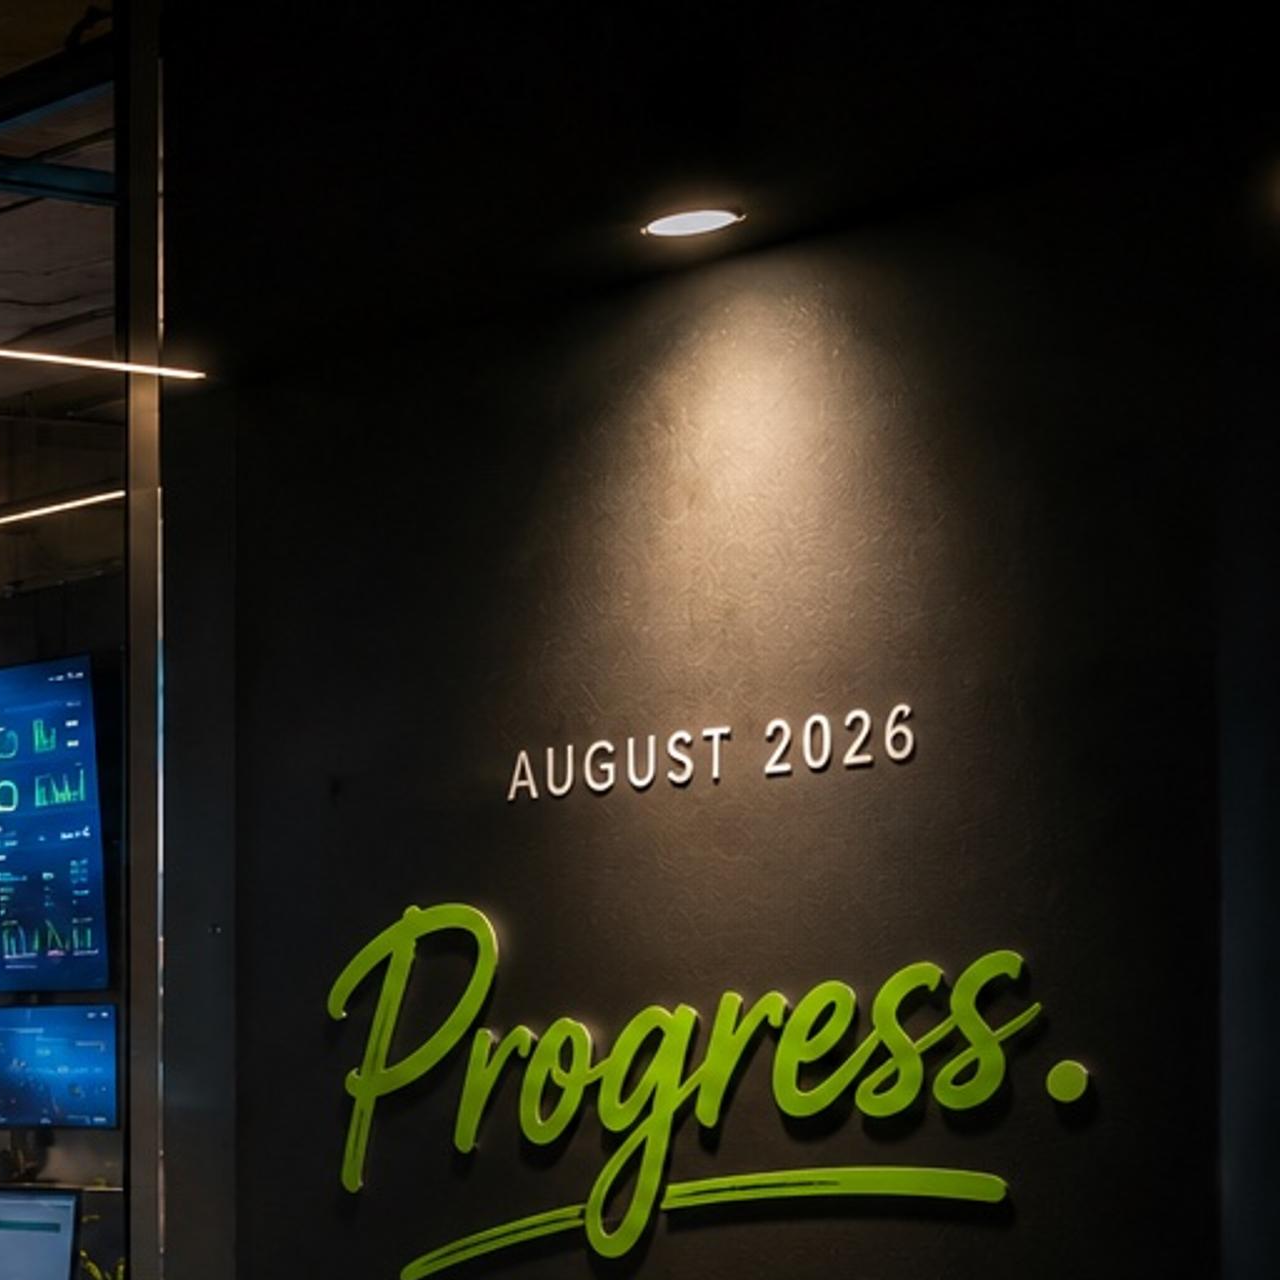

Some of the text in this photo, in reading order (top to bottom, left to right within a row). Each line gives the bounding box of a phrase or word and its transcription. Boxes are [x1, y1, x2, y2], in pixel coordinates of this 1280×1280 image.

[508, 703, 915, 800] AUGUST 2026
[328, 903, 1088, 1258] Progress.
